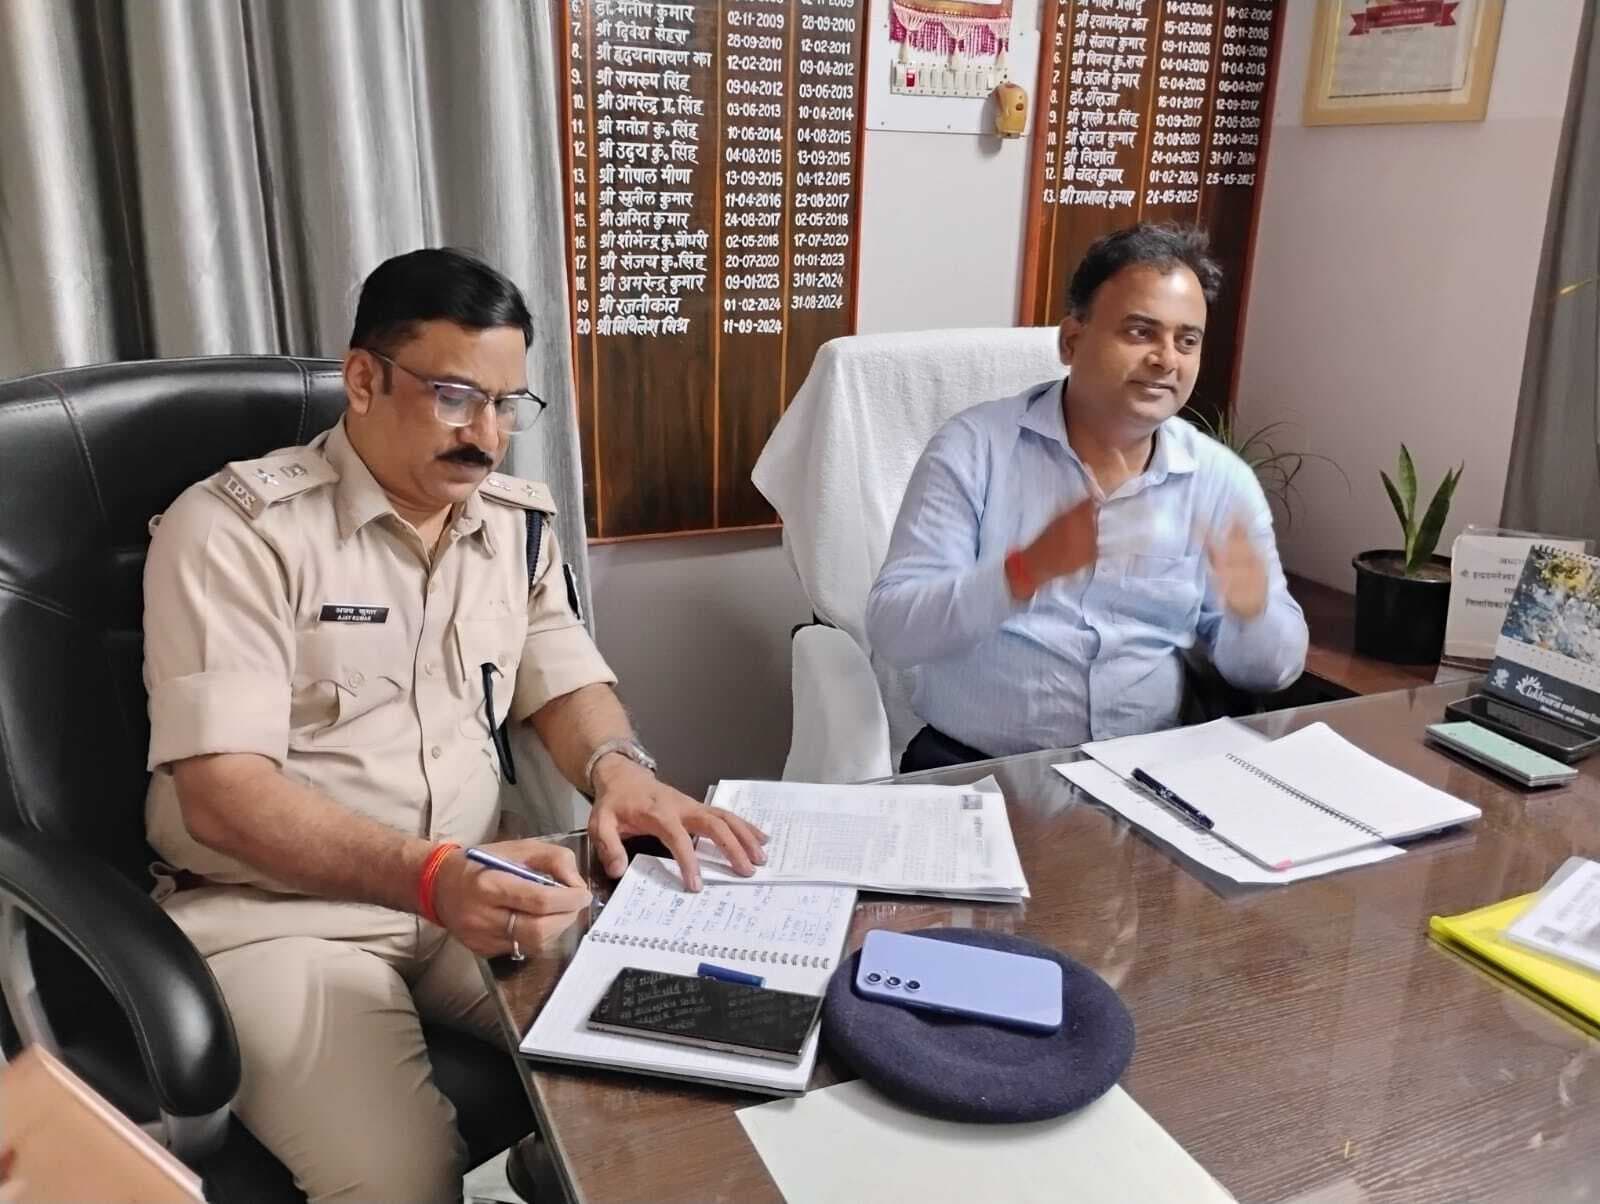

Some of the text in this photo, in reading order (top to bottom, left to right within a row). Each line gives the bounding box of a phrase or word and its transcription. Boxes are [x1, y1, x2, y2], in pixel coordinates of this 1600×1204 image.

[656, 4, 695, 23] कुमार
[728, 11, 784, 28] 02-11-2009
[802, 15, 855, 32] 28-09-2010
[1075, 9, 1089, 28] श्री
[596, 19, 612, 37] श्री
[727, 33, 783, 50] 28-09-2010
[801, 38, 851, 55] 12-02-2011
[1073, 30, 1087, 47] श्री
[1089, 32, 1118, 49] संजय
[1118, 36, 1147, 53] कुमार
[596, 42, 612, 60] श्री
[726, 55, 782, 72] 12-02-2011
[800, 59, 854, 76] 09-04-2012
[1071, 48, 1086, 65] श्री
[596, 67, 614, 86] श्री
[663, 70, 690, 91] सिंह
[726, 79, 783, 96] 09-04-2012
[799, 84, 853, 99] 03-06-2013
[1070, 67, 1084, 85] श्री
[1111, 73, 1141, 91] कुमार
[597, 90, 615, 110] श्री
[676, 94, 704, 116] सिंह
[727, 102, 781, 118] 03-06-2013
[799, 106, 854, 121] 10-04-2014
[1066, 107, 1080, 125] श्री
[1117, 108, 1140, 128] सिंह
[597, 115, 613, 135] श्री
[615, 116, 650, 135] मनोज
[671, 119, 699, 140] सिंह
[728, 126, 783, 142] 10-06-2014
[797, 128, 851, 144] 04-08-2015
[1064, 126, 1080, 145] श्री
[1107, 131, 1138, 149] कुमार
[598, 138, 615, 159] श्री
[615, 142, 650, 163] उदय
[669, 140, 699, 164] सिंह
[726, 147, 782, 164] 04-08-2015
[797, 150, 851, 165] 13-09-2015
[1063, 147, 1079, 165] श्री
[1080, 147, 1118, 167] निशांत
[599, 163, 616, 184] श्री
[618, 164, 658, 184] गोपाल
[660, 164, 693, 184] मीणा
[725, 171, 783, 186] 13-09-2015
[796, 172, 851, 186] 04-12-2015
[1063, 164, 1076, 181] श्री
[1097, 168, 1124, 187] कुमार
[599, 186, 617, 205] श्री
[618, 187, 657, 208] सुनील
[659, 192, 694, 209] कुमार
[725, 193, 781, 208] 11-04-2016
[795, 193, 850, 208] 23-08-2017
[1059, 185, 1076, 205] श्री
[1109, 190, 1136, 209] कुमार
[599, 208, 615, 226] श्री
[615, 208, 652, 227] अमित
[653, 213, 690, 230] कुमार
[725, 213, 781, 226] 24-08-2017
[795, 213, 848, 226] 02-05-2018
[599, 230, 616, 249] श्री
[725, 234, 779, 248] 02-05-2018
[794, 234, 848, 247] 17-07-2020
[599, 250, 617, 270] श्री
[620, 252, 659, 270] संजय
[725, 254, 780, 268] 20-07-2020
[793, 253, 845, 266] 01-01-2023
[599, 272, 616, 292] श्री
[670, 275, 706, 294] कुमार
[792, 272, 843, 288] 31-01-2024
[598, 294, 616, 313] श्री
[723, 298, 781, 311] 01-02-2024
[576, 318, 591, 335] 20
[597, 315, 613, 335] श्री
[723, 319, 783, 334] 11-09-2024
